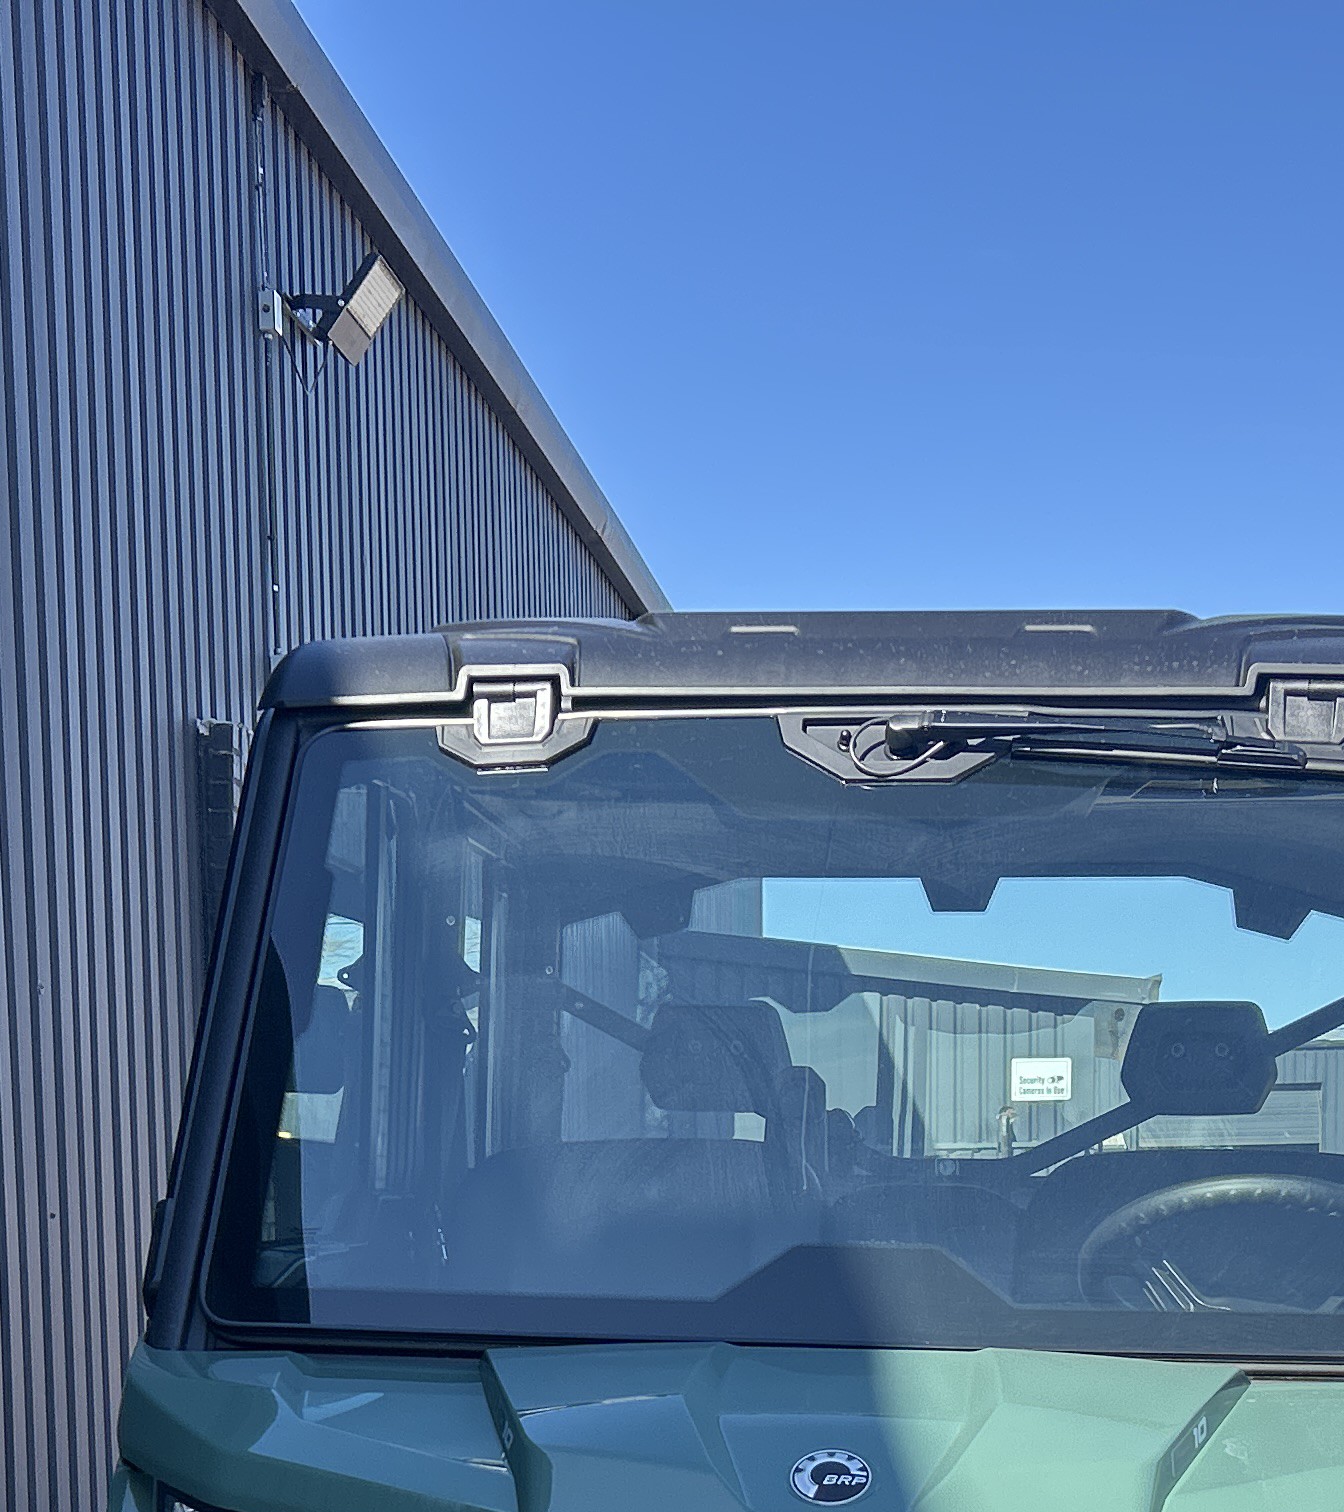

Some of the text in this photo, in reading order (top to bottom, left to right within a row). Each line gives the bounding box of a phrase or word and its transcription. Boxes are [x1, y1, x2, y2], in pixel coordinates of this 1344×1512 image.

[1019, 1076, 1045, 1086] Security
[1019, 1086, 1045, 1095] Cameras
[1193, 1416, 1207, 1448] 10
[823, 1474, 867, 1486] BRP
